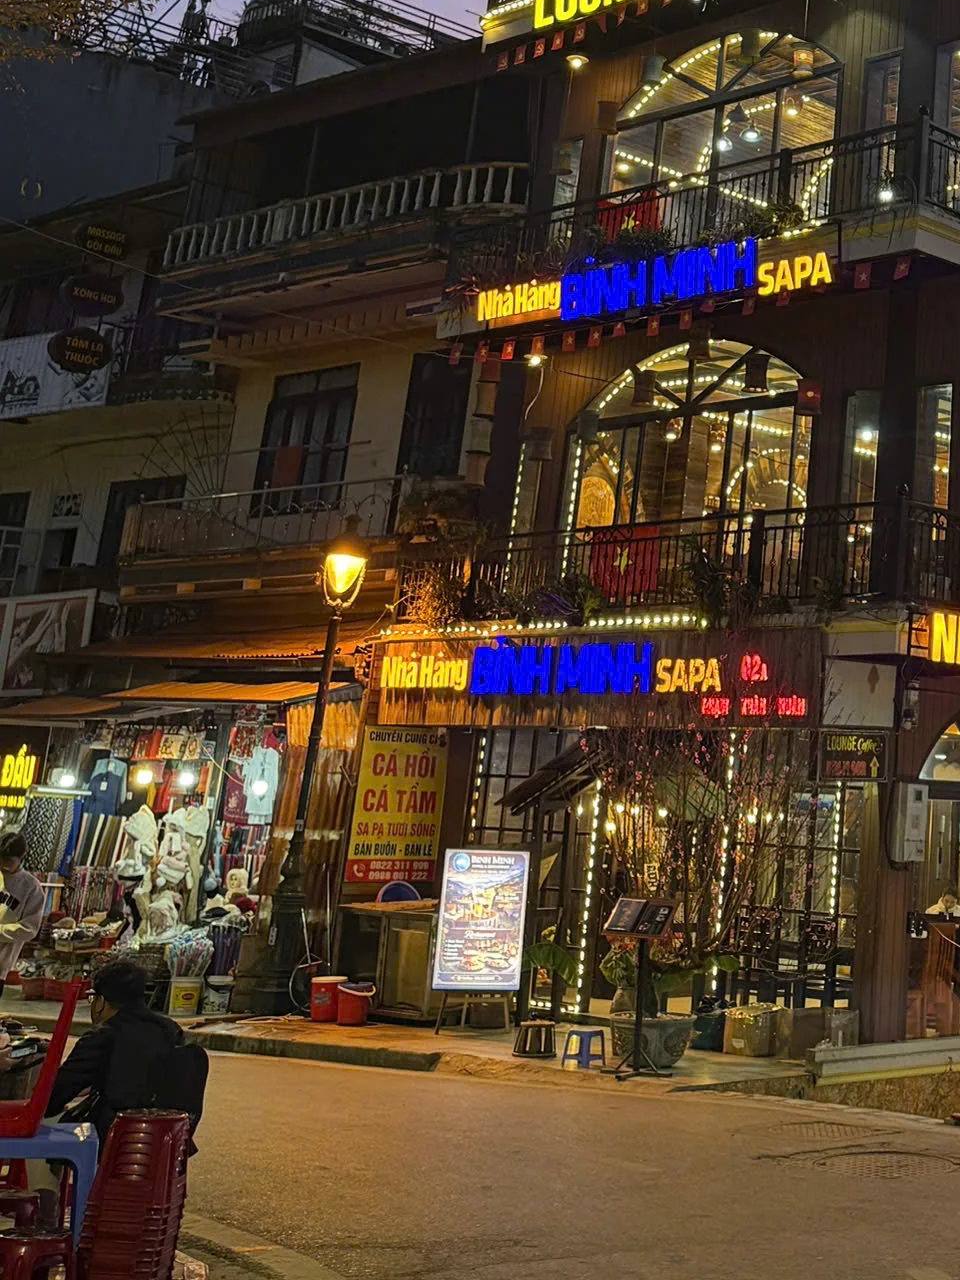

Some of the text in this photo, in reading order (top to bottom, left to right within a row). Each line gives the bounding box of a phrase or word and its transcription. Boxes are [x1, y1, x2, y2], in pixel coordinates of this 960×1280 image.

[87, 226, 127, 245] MASSAGE
[477, 284, 514, 321] Nhà
[561, 256, 647, 320] BÌNH
[652, 237, 757, 304] MINH
[757, 252, 833, 297] SAPA
[380, 650, 419, 689] Nhà
[555, 641, 653, 695] MINH
[655, 657, 722, 693] SAPA
[404, 733, 426, 743] CUNG
[827, 735, 857, 751] LOUNGE
[372, 748, 436, 778] CÁ HỒI
[362, 782, 437, 813] CÁ TẦM
[356, 822, 369, 836] SA
